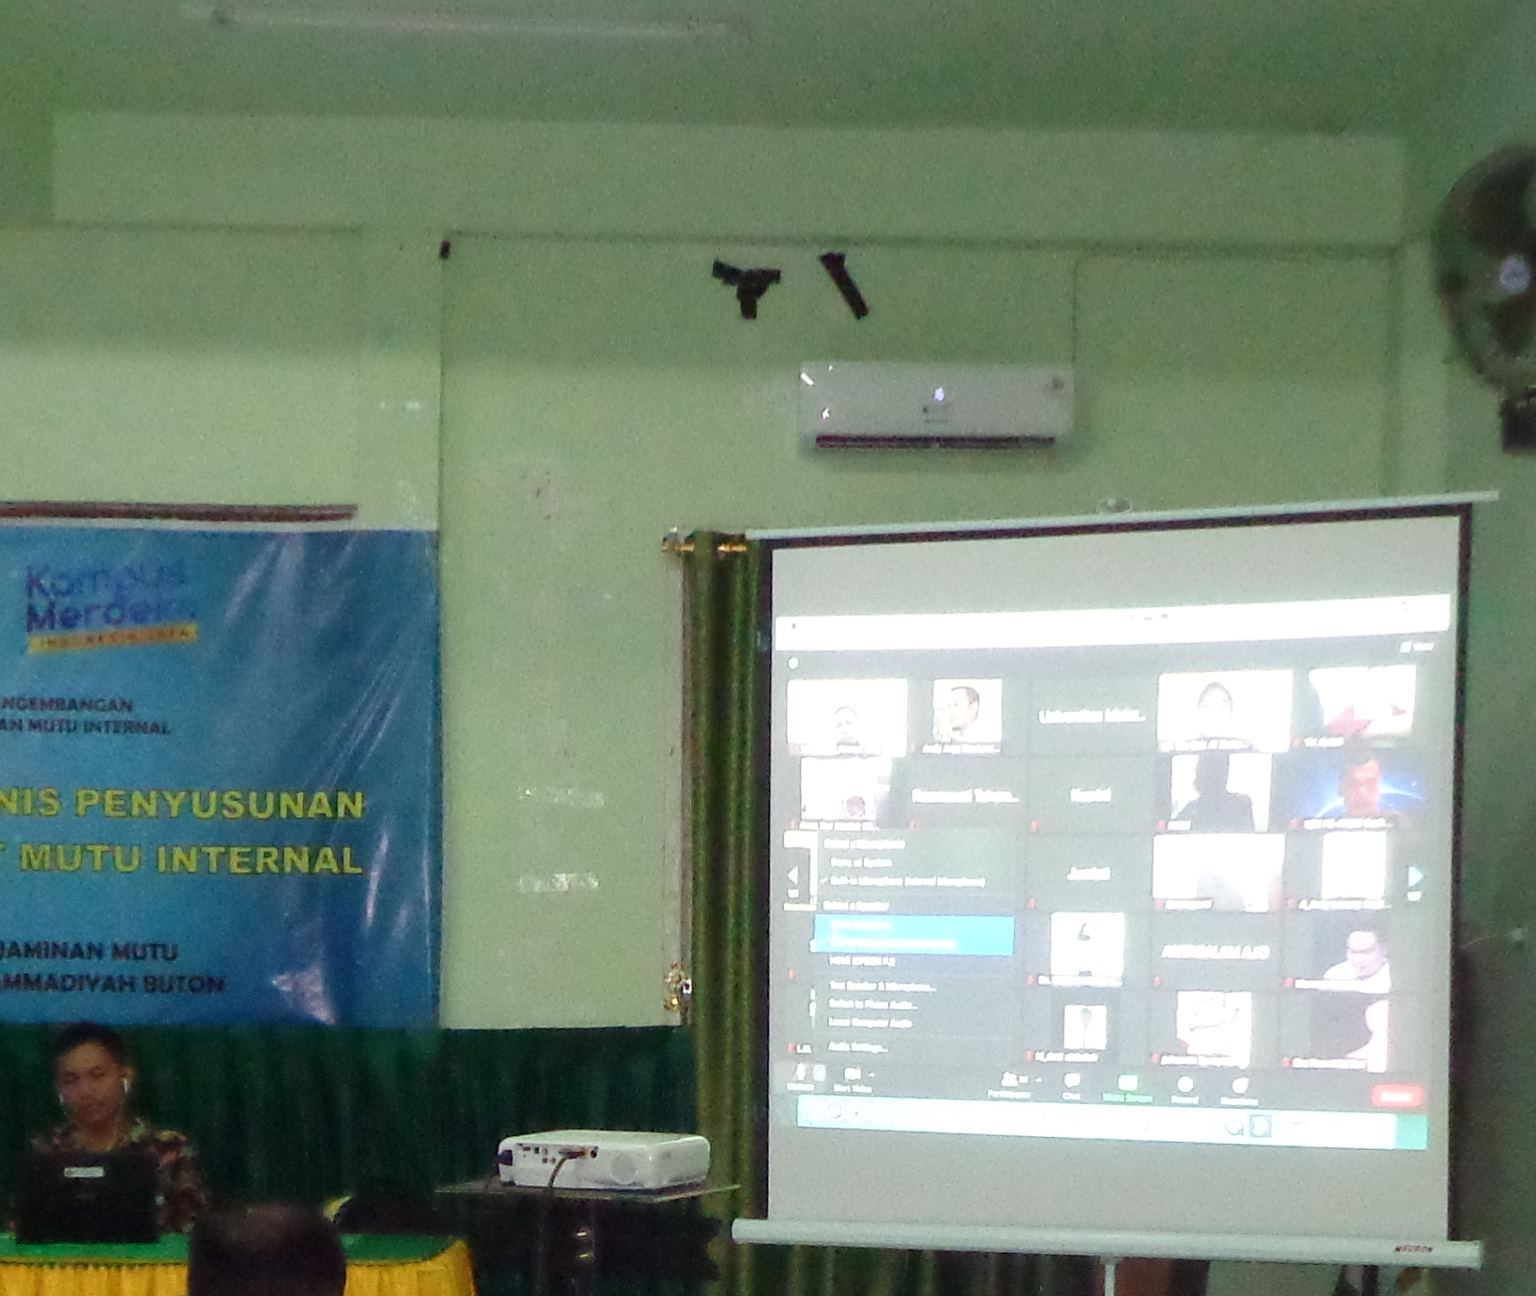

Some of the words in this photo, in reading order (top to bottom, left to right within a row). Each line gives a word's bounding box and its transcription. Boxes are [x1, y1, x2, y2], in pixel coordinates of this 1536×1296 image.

[28, 718, 77, 733] MUTU
[83, 719, 171, 735] INTERNAL
[75, 787, 365, 819] PENYUSUNAN
[20, 842, 143, 873] MUTU
[157, 845, 365, 875] INTERNAL
[111, 942, 179, 961] MUTU
[143, 975, 225, 993] BUTON
